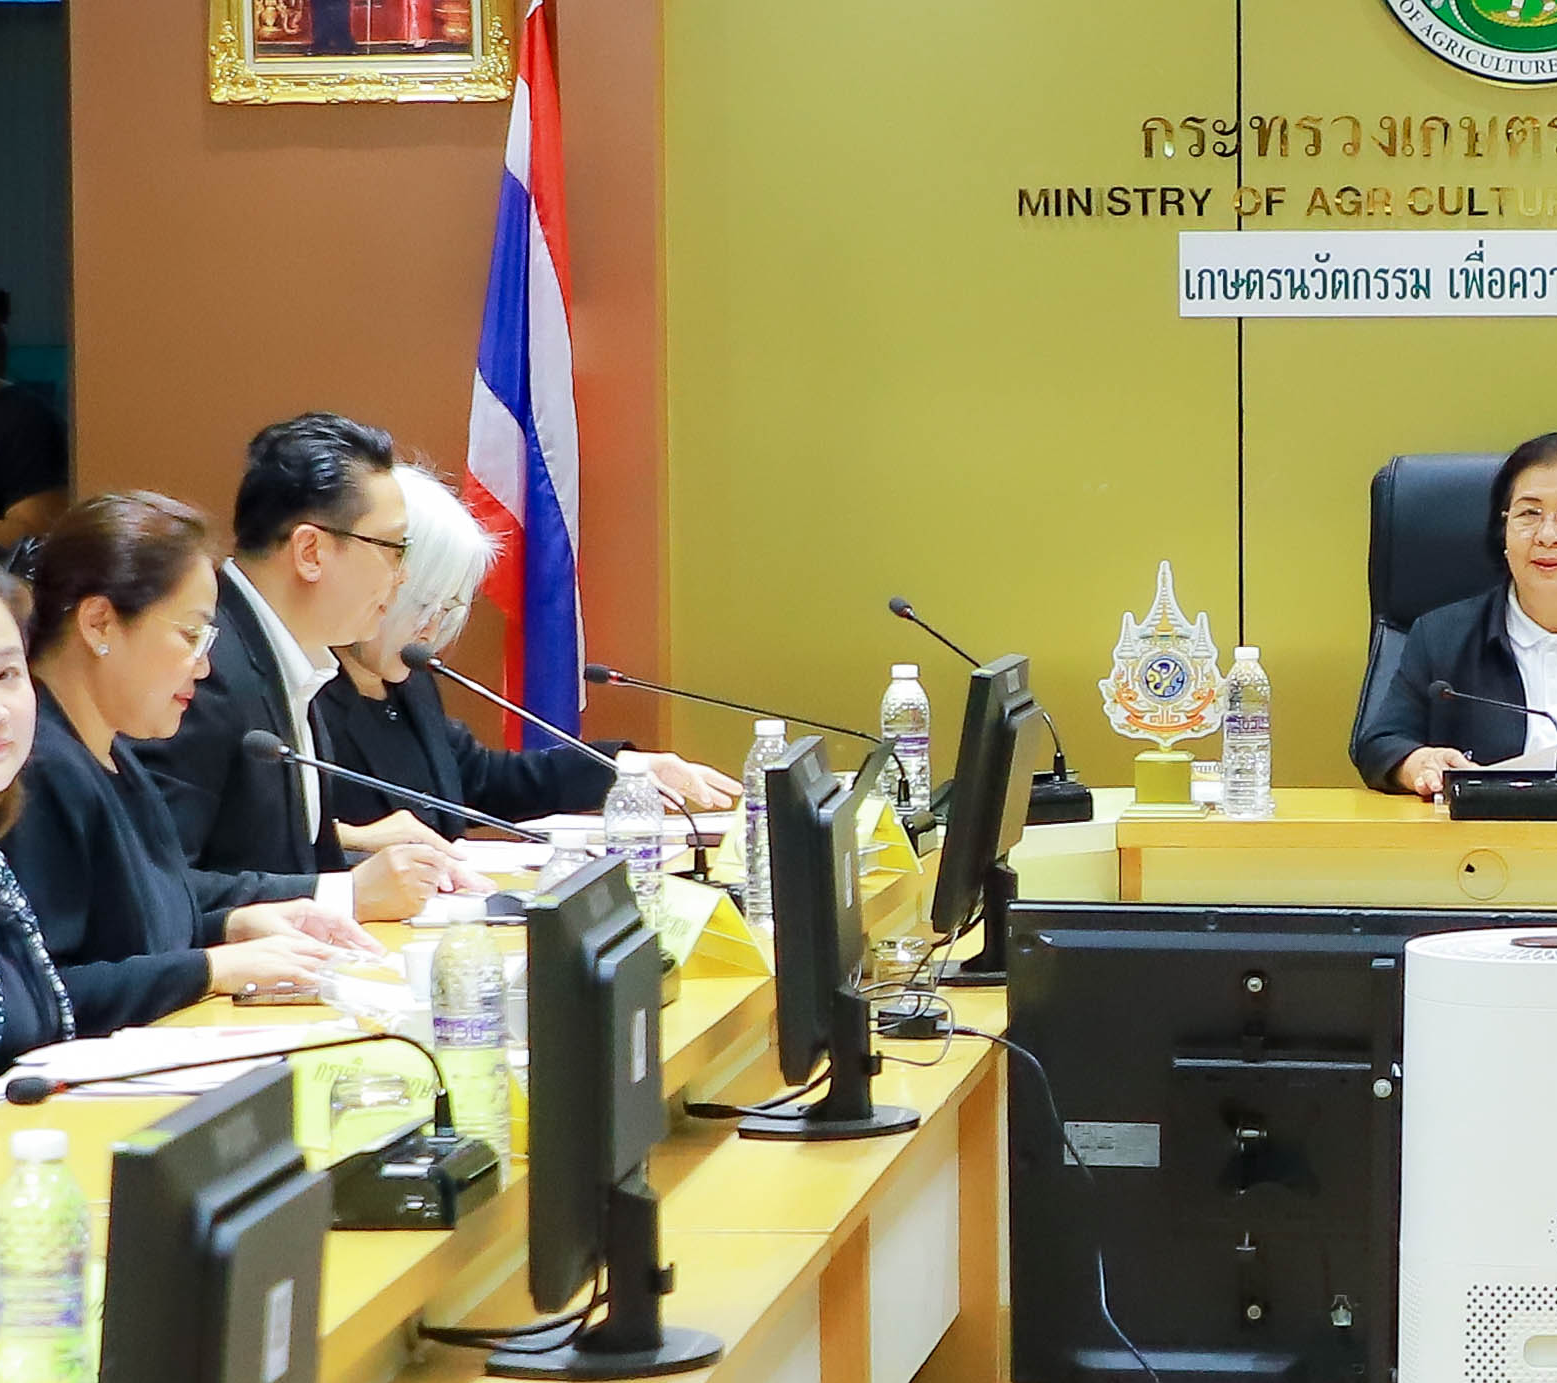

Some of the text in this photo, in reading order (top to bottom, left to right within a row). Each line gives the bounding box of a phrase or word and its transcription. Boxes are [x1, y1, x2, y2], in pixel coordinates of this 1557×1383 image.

[1017, 186, 1213, 217] MINISTRY
[1232, 186, 1286, 217] OF
[1184, 252, 1432, 301] เกษตรนวัตกรรม
